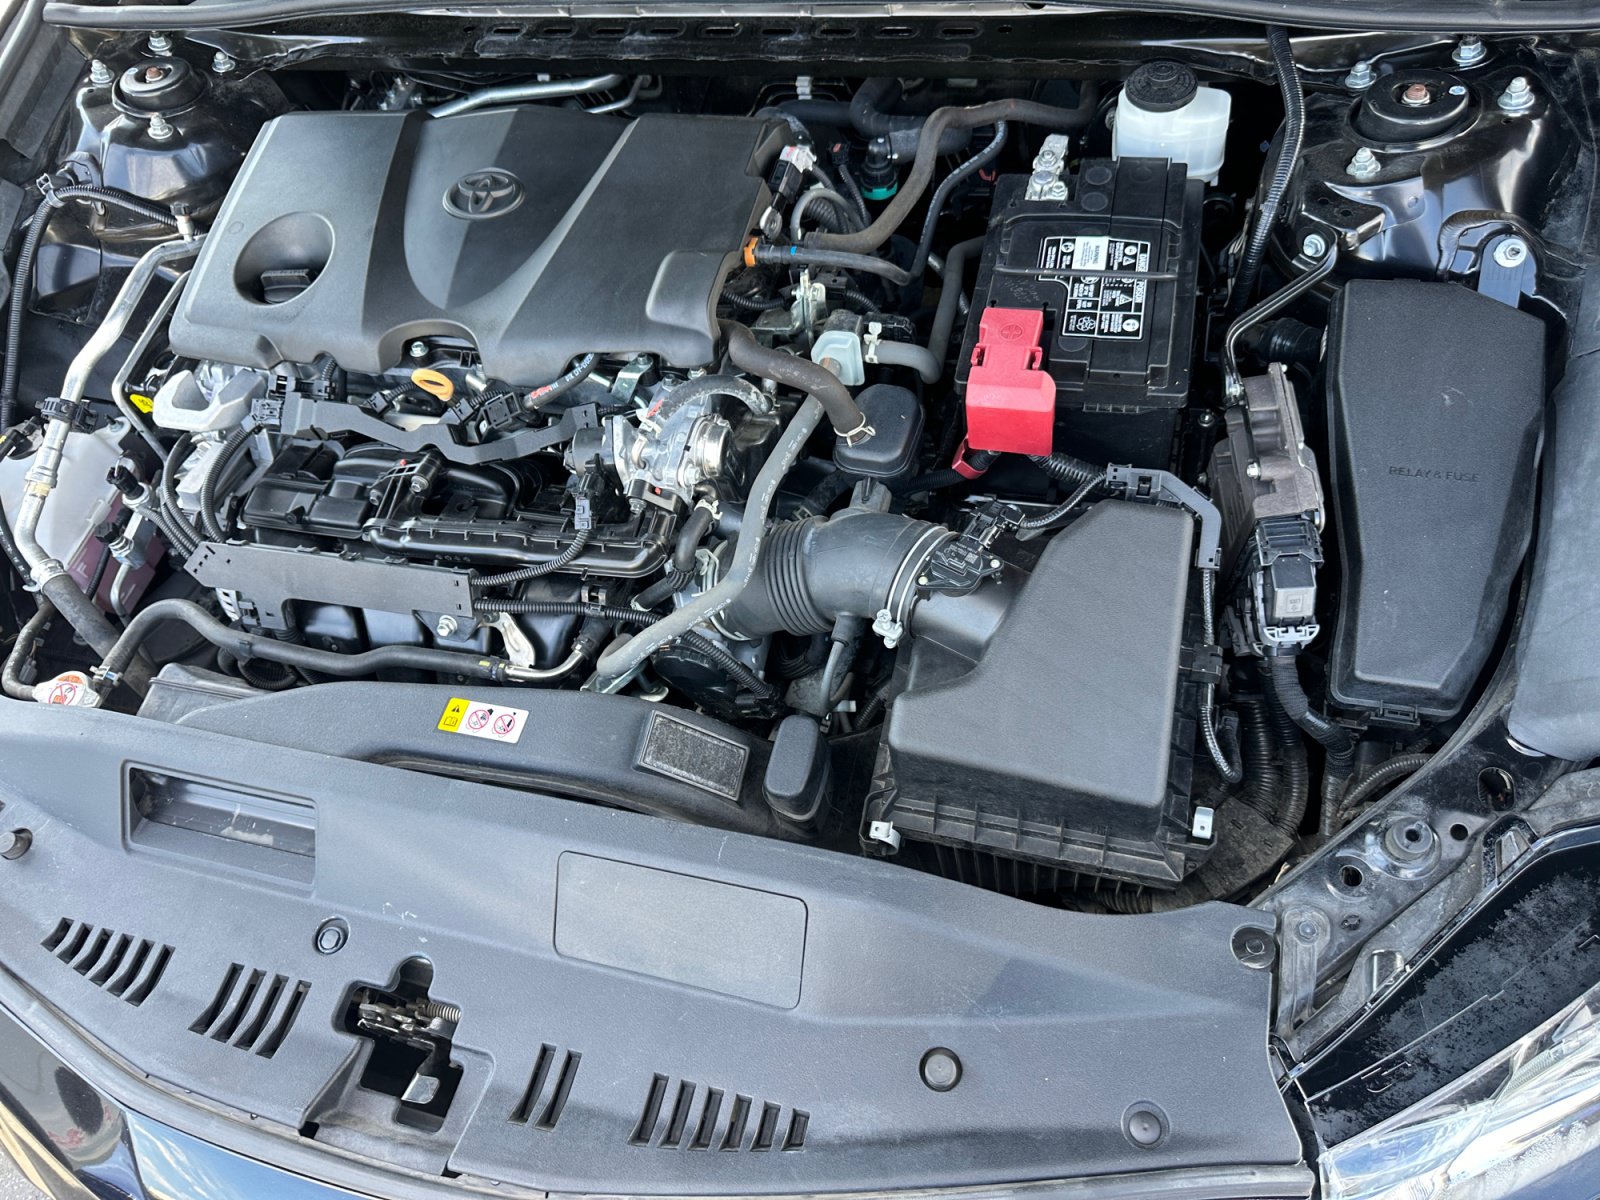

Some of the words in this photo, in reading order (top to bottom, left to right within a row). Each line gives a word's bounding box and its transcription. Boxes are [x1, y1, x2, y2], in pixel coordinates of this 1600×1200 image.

[1388, 466, 1431, 478] RELAY
[1432, 470, 1442, 479] &
[1446, 471, 1480, 482] FUSE
